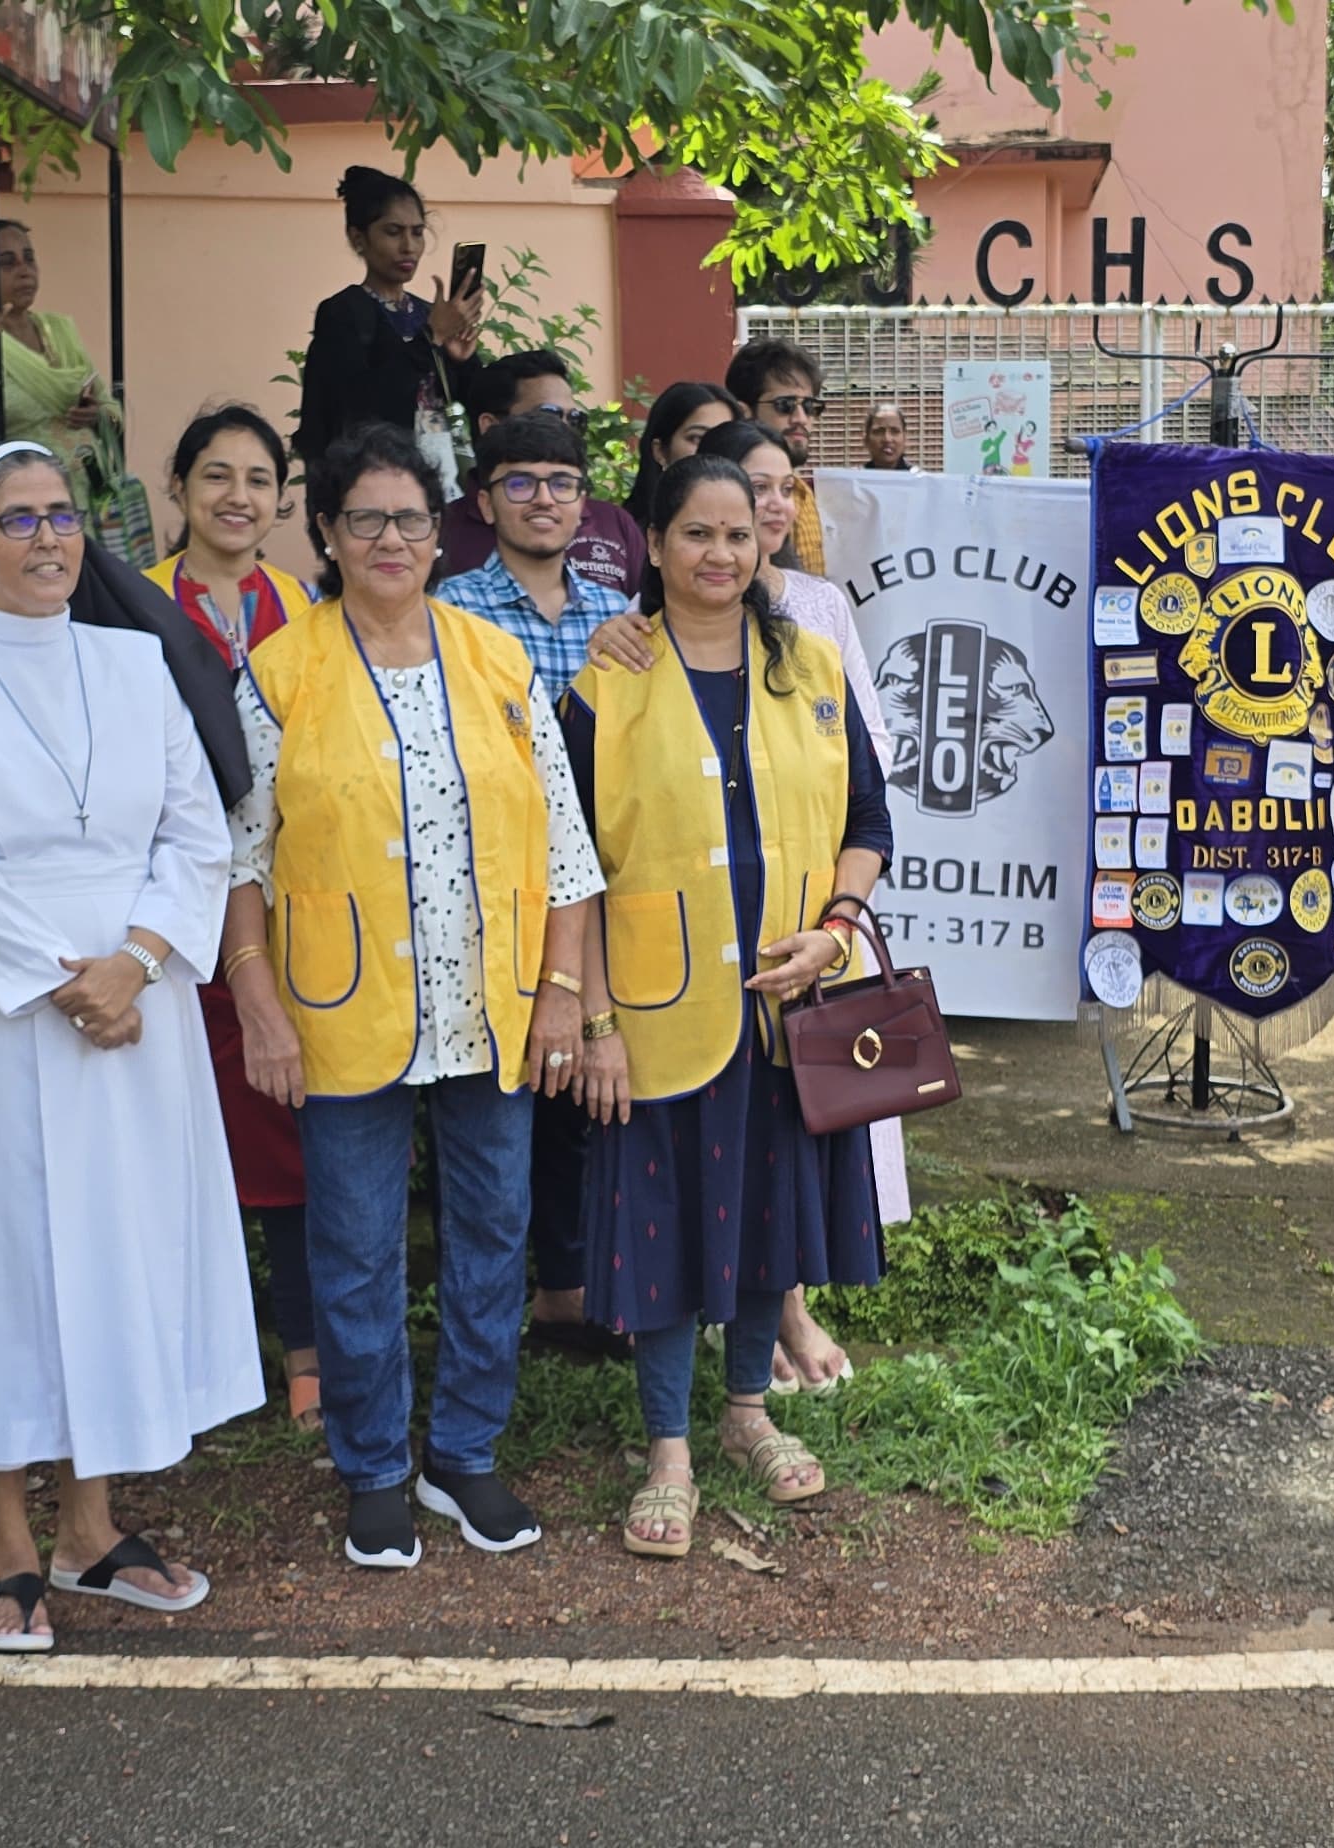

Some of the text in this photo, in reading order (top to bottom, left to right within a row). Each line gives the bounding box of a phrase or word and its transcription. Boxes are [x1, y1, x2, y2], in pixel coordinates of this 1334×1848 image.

[1115, 470, 1261, 585] LIONS
[845, 545, 1077, 609] LEO CLUB
[1219, 576, 1304, 618] LIONS
[1251, 622, 1292, 683] L
[932, 633, 969, 793] LEO
[1217, 694, 1302, 728] INTERNATIONAL
[880, 856, 1057, 900] BOLIM
[1192, 845, 1252, 869] DIST.
[875, 913, 918, 940] ST
[946, 917, 1010, 947] 317
[1022, 923, 1044, 949] B
